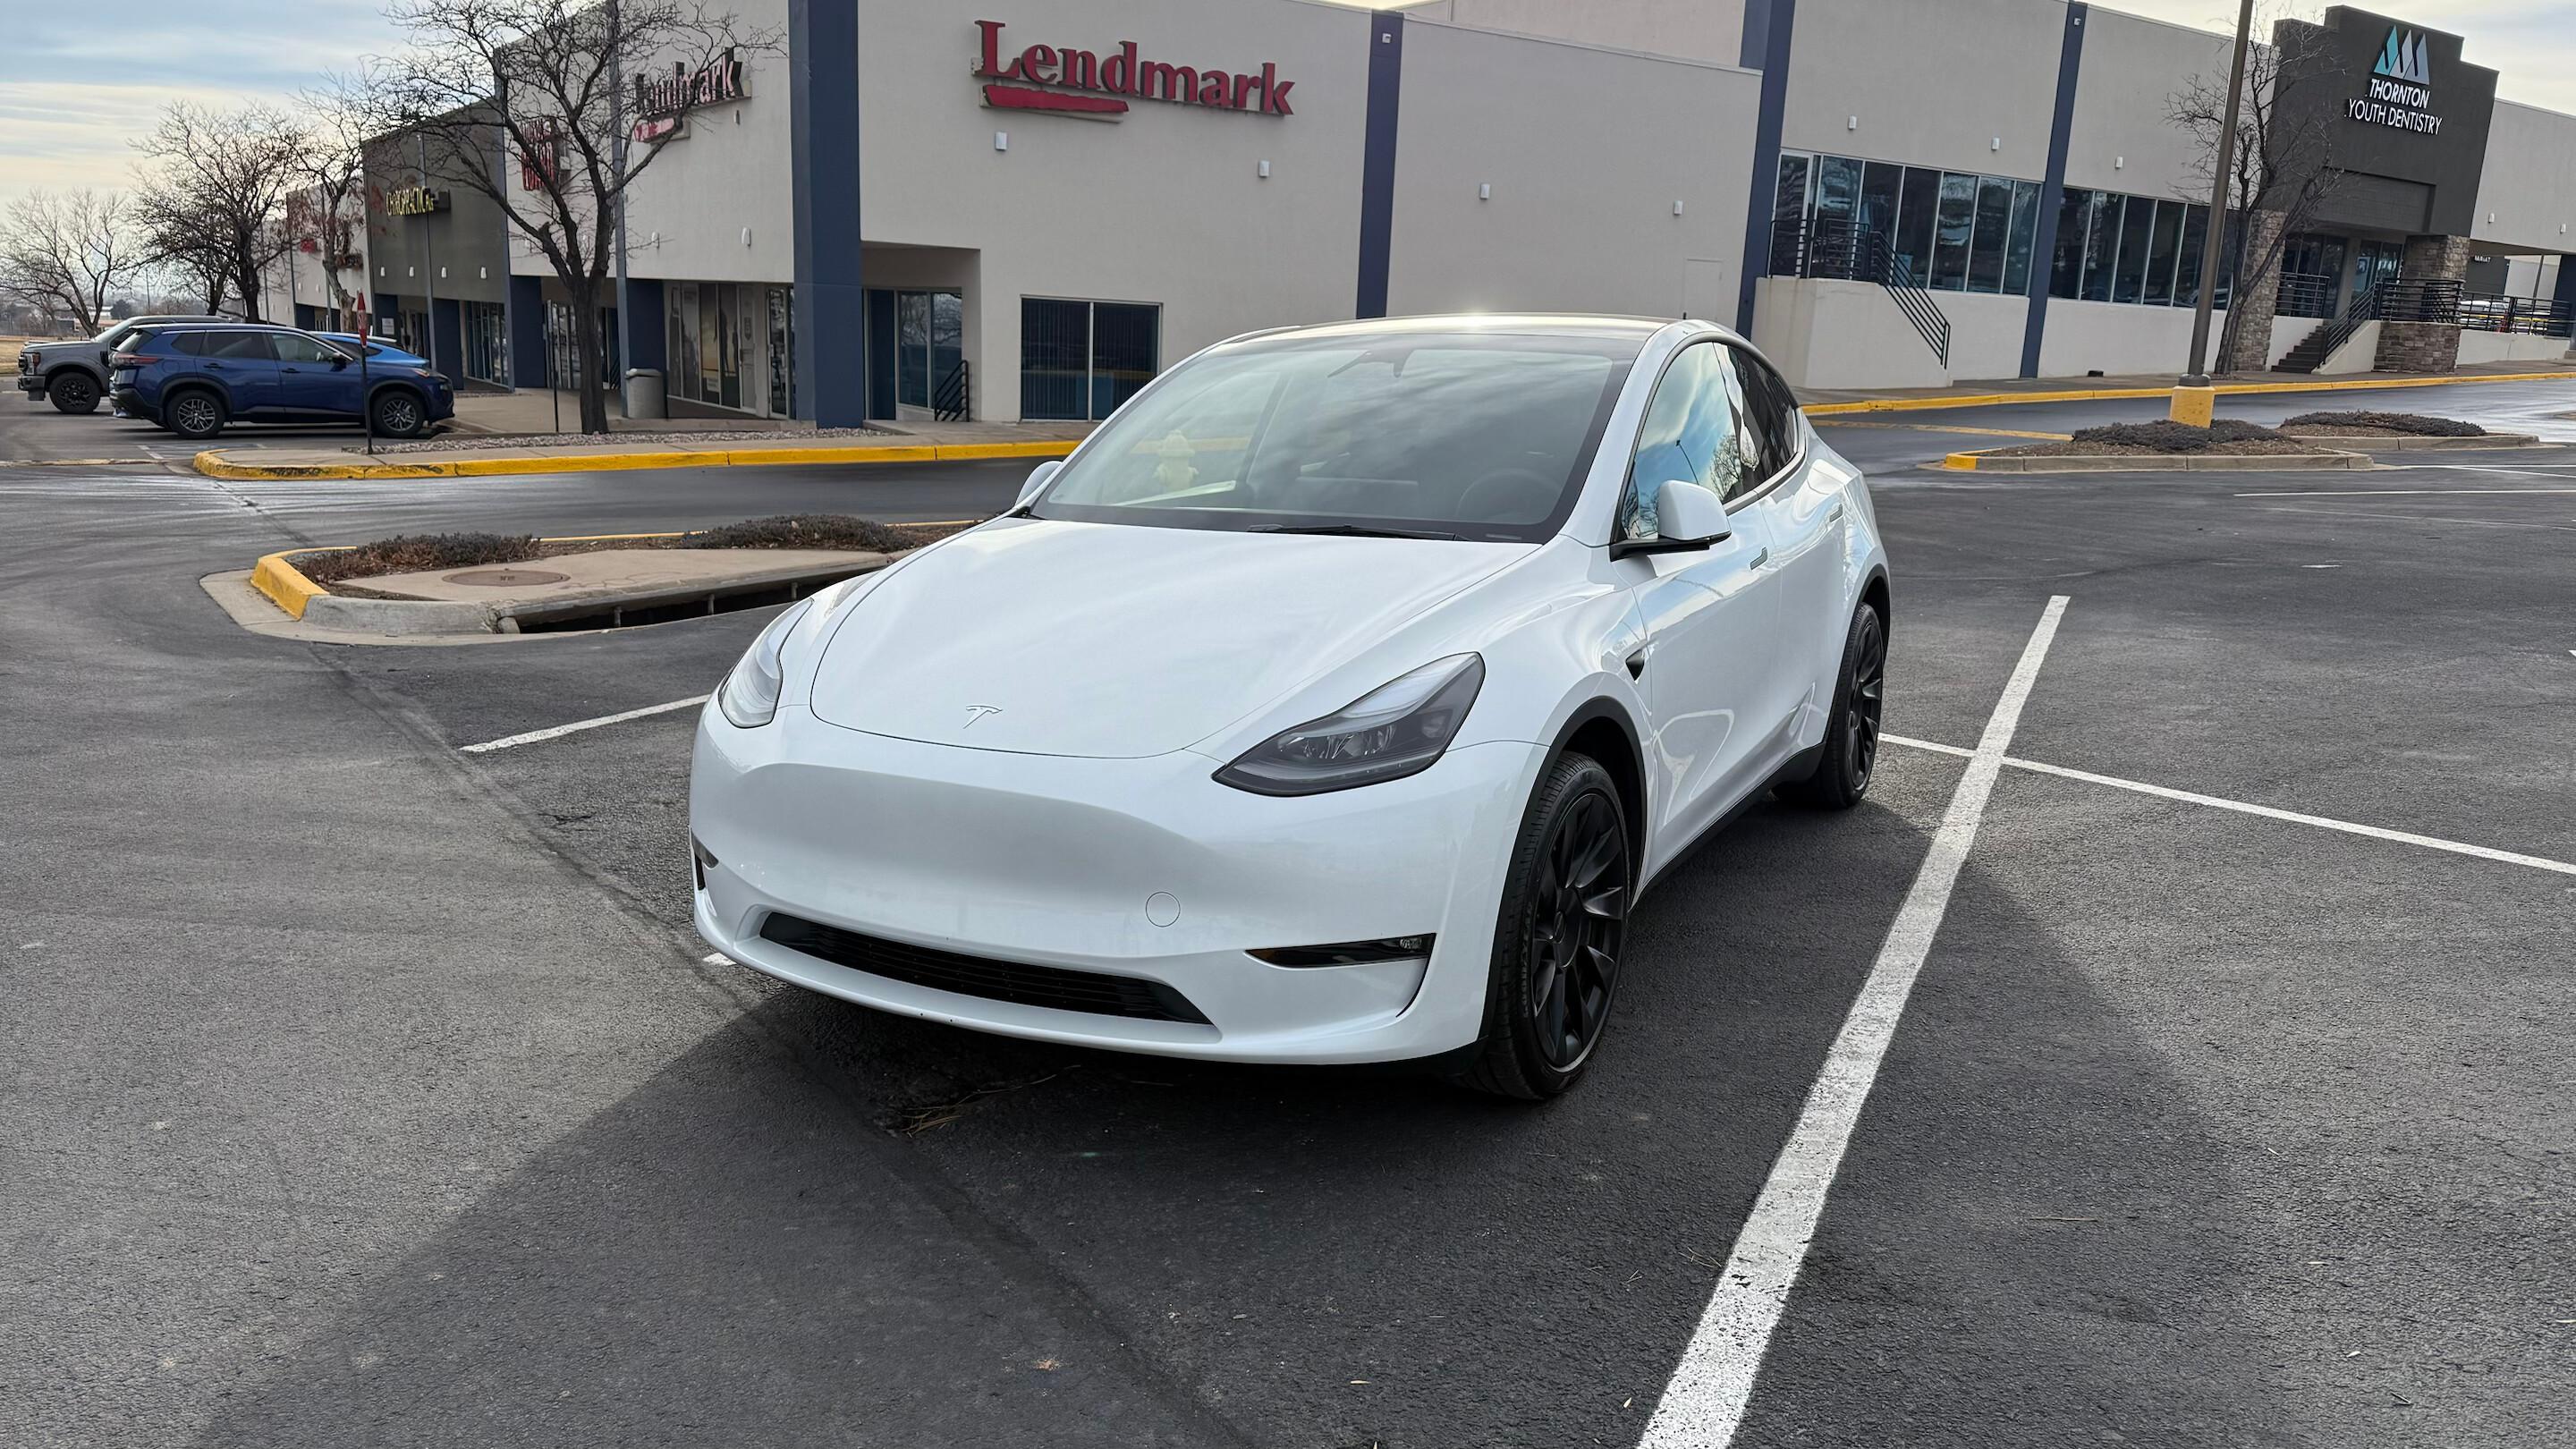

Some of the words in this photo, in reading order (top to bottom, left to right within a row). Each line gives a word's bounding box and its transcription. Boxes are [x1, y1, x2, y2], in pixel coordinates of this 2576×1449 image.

[974, 20, 1295, 114] Lendmark
[2368, 78, 2430, 109] THORNTON
[2348, 97, 2387, 125] YOUTH
[2387, 106, 2443, 135] DENTISTRY
